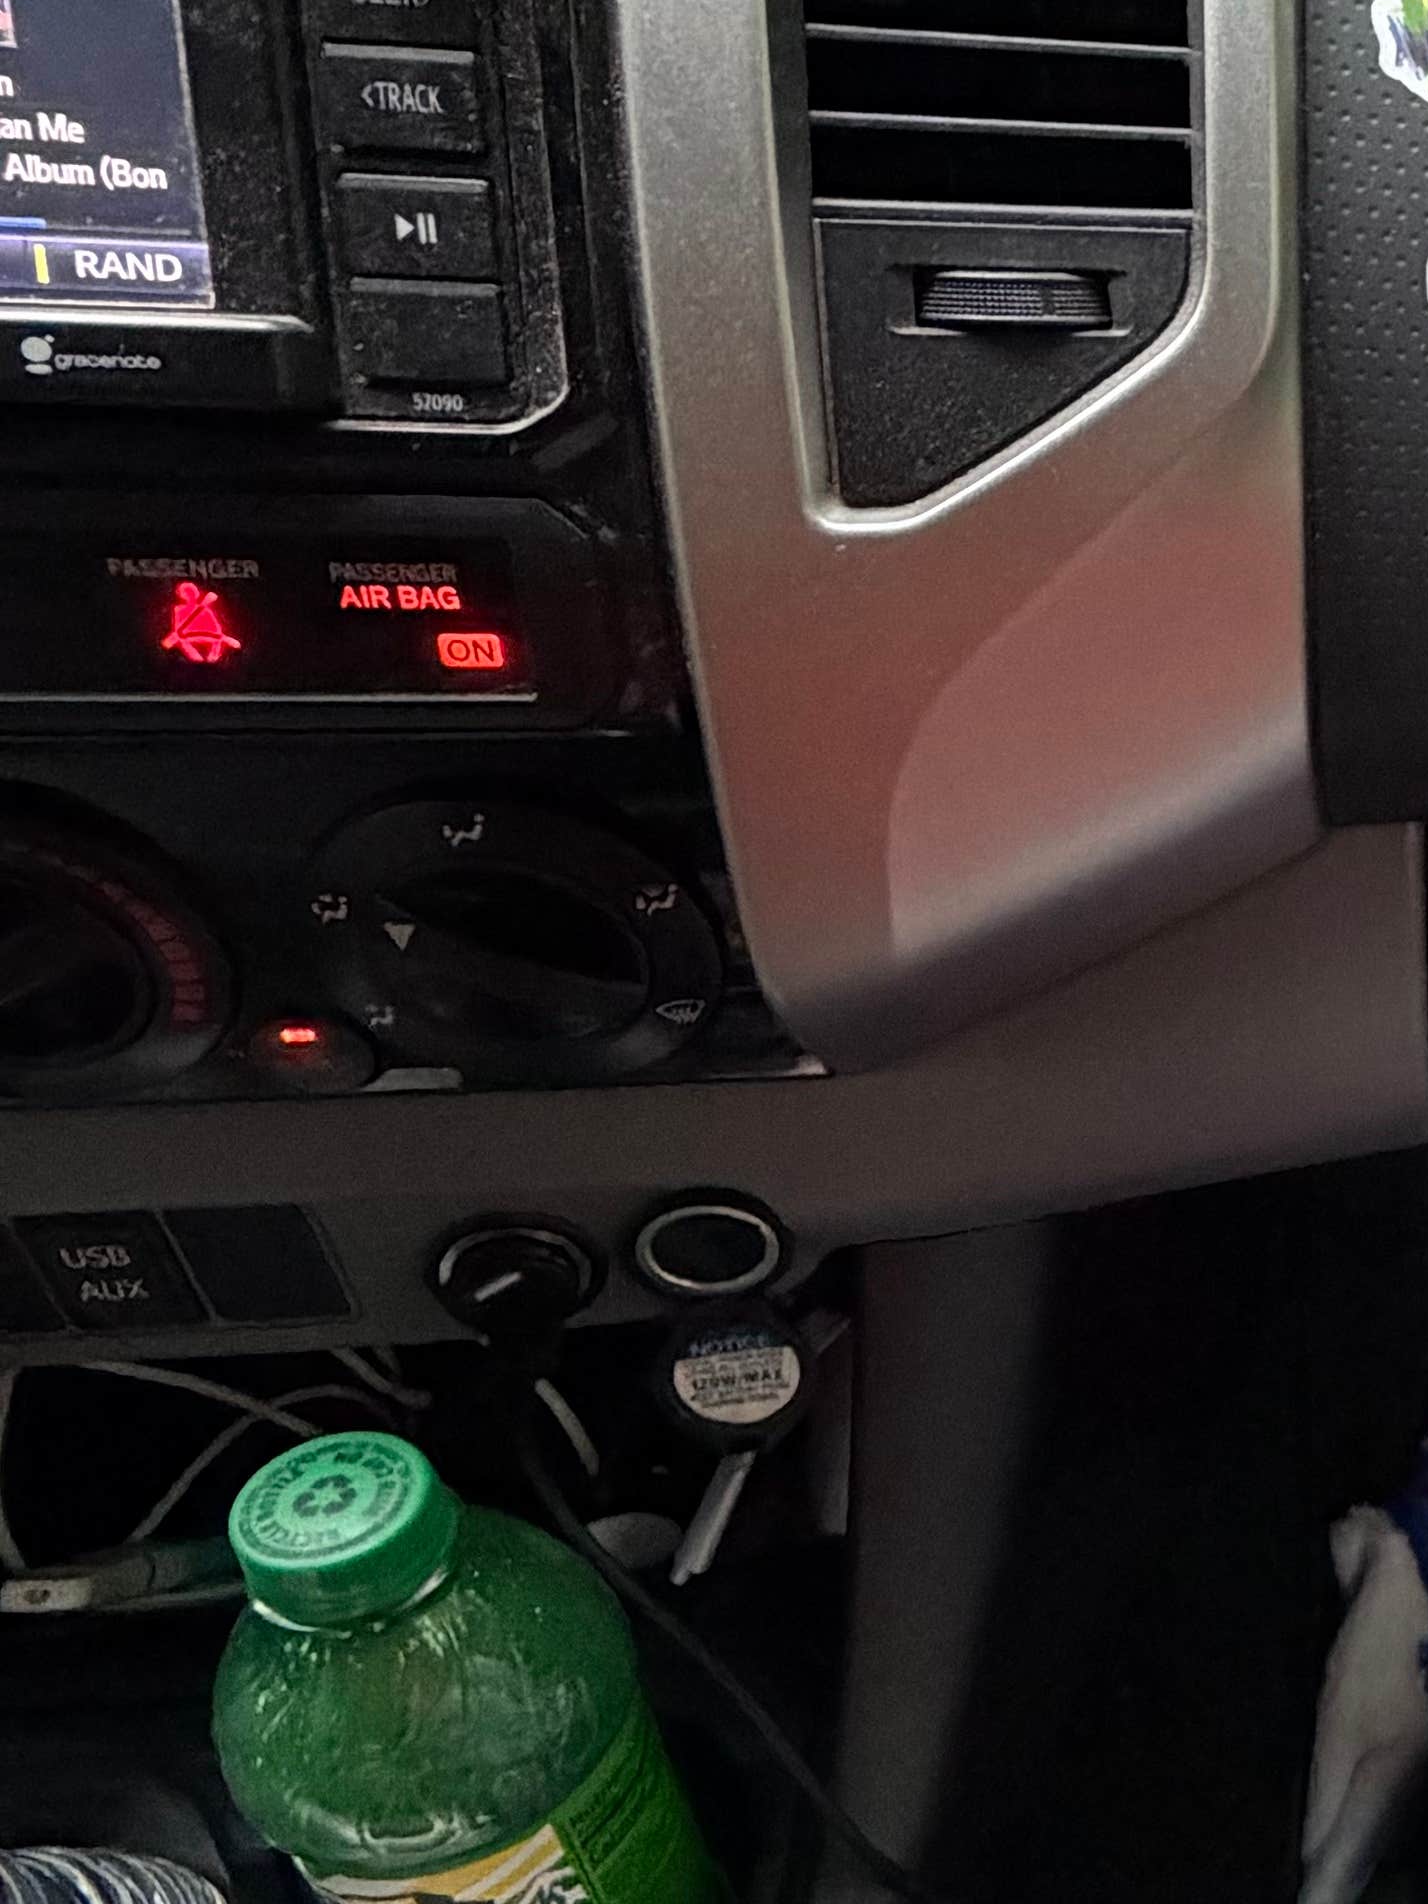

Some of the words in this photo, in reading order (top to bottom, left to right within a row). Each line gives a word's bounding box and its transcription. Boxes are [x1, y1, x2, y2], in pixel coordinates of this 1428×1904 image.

[0, 117, 34, 141] an
[36, 111, 85, 144] Me
[5, 152, 96, 187] Album
[100, 154, 168, 191] (Bon
[74, 248, 183, 283] RAND
[106, 558, 259, 579] PASSENGER
[329, 561, 458, 583] PASSENGER
[340, 585, 391, 609] AIR
[398, 586, 460, 610] BAG
[447, 639, 495, 663] ON
[60, 1245, 131, 1269] USB
[81, 1278, 151, 1302] AUX
